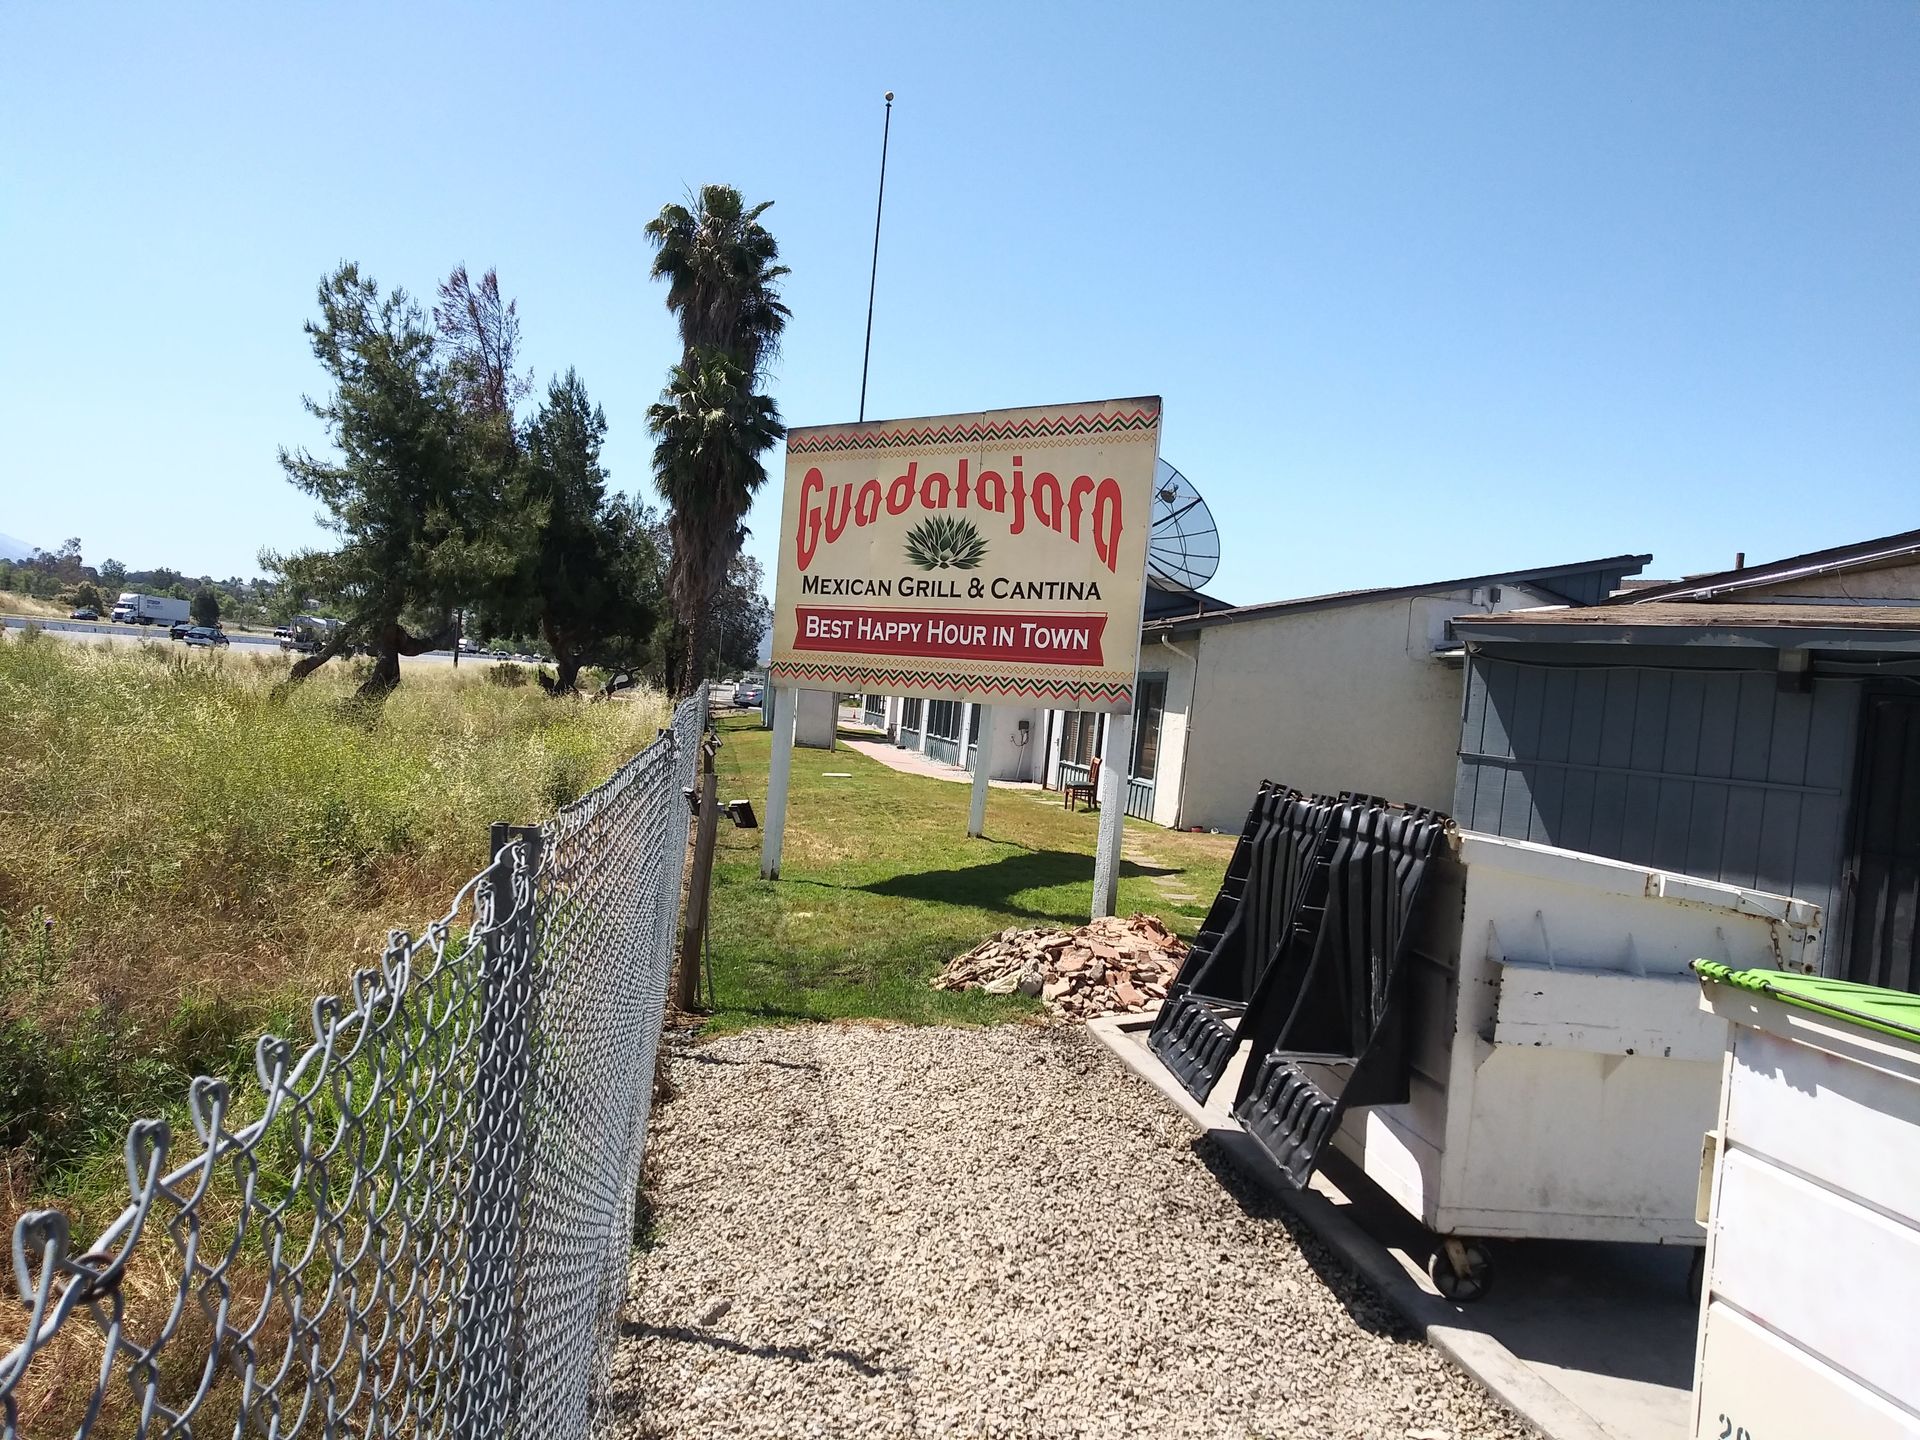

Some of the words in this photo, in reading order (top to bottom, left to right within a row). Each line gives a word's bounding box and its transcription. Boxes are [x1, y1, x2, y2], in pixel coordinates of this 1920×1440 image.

[796, 455, 1124, 574] Guadalajara
[801, 575, 892, 597] MEXICAN
[897, 577, 961, 598] GRILL
[968, 577, 984, 599] &
[991, 578, 1102, 600] CANTINA
[805, 616, 854, 640] BEST
[856, 618, 923, 642] HAPPY
[927, 620, 987, 645] HOUR
[992, 626, 1014, 646] IN
[1020, 623, 1089, 650] TOWN
